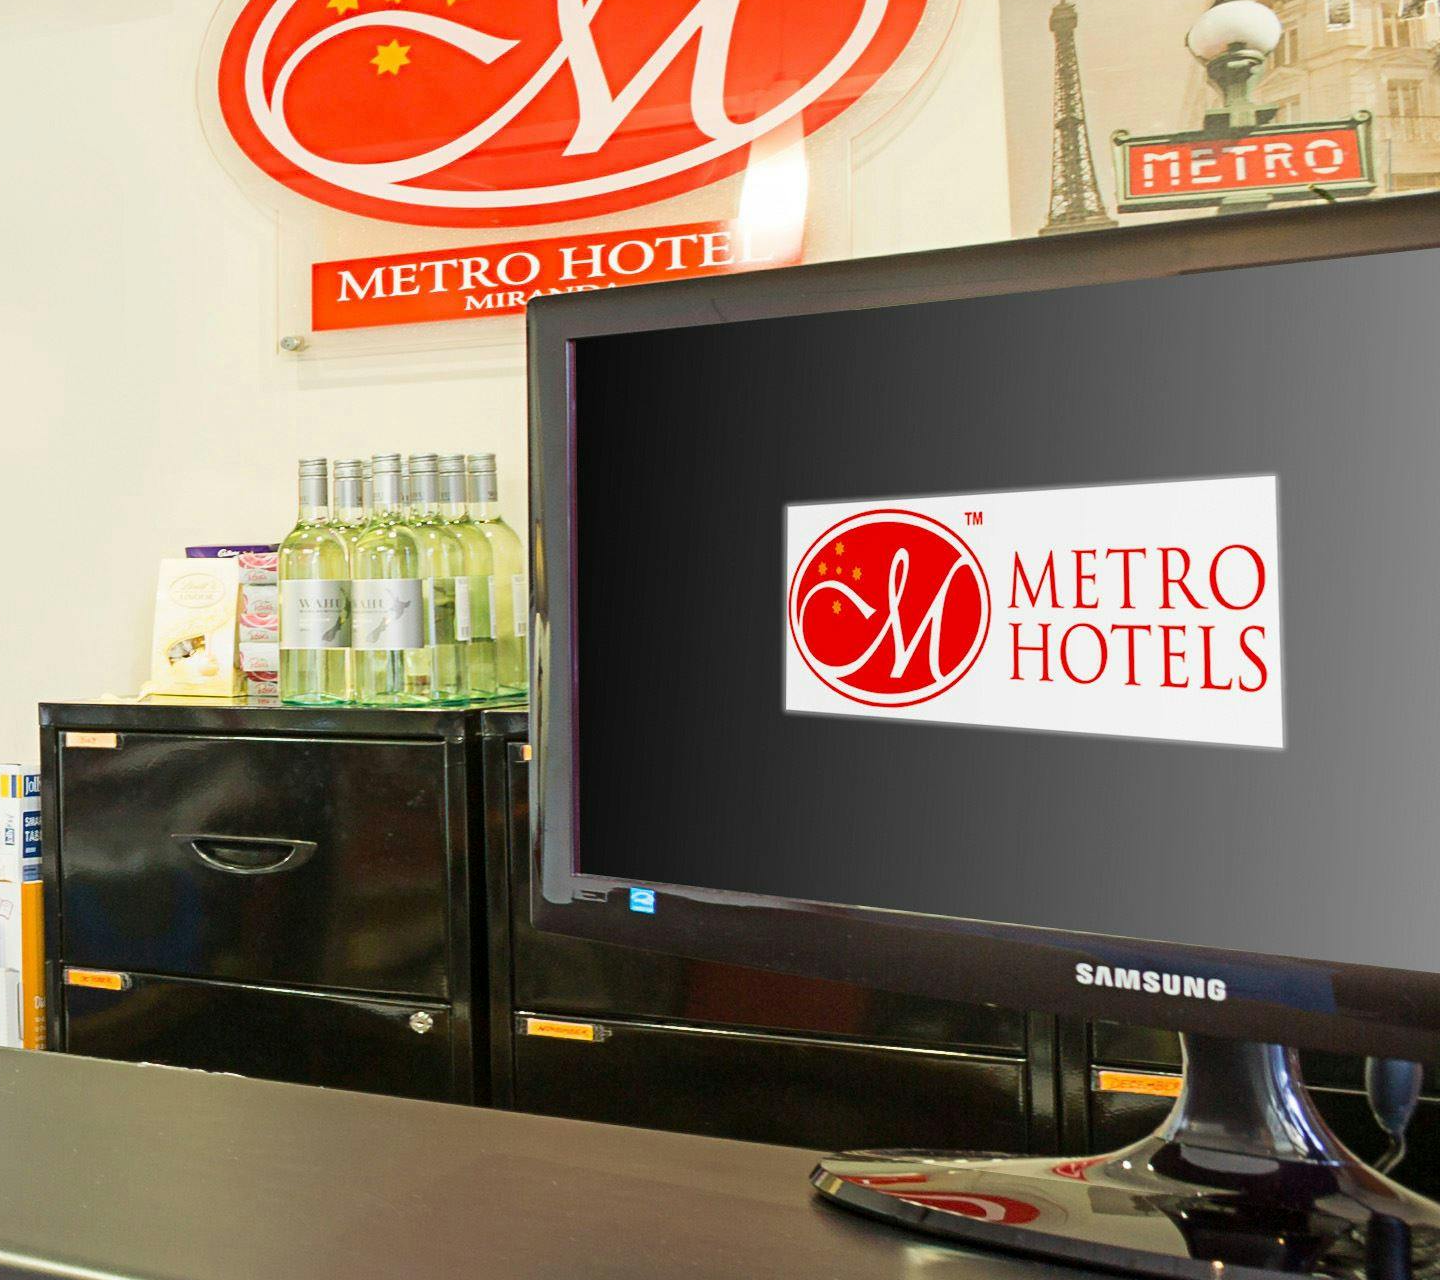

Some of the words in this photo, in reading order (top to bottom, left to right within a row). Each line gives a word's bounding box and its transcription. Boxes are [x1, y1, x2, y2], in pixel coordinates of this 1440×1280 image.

[1143, 139, 1344, 188] METRO
[337, 251, 540, 302] METRO
[559, 231, 775, 281] HOTEL
[964, 512, 983, 525] TM
[1008, 544, 1266, 610] METRO
[1009, 623, 1268, 692] HOTELS
[1076, 962, 1227, 1002] SAMSUNG
